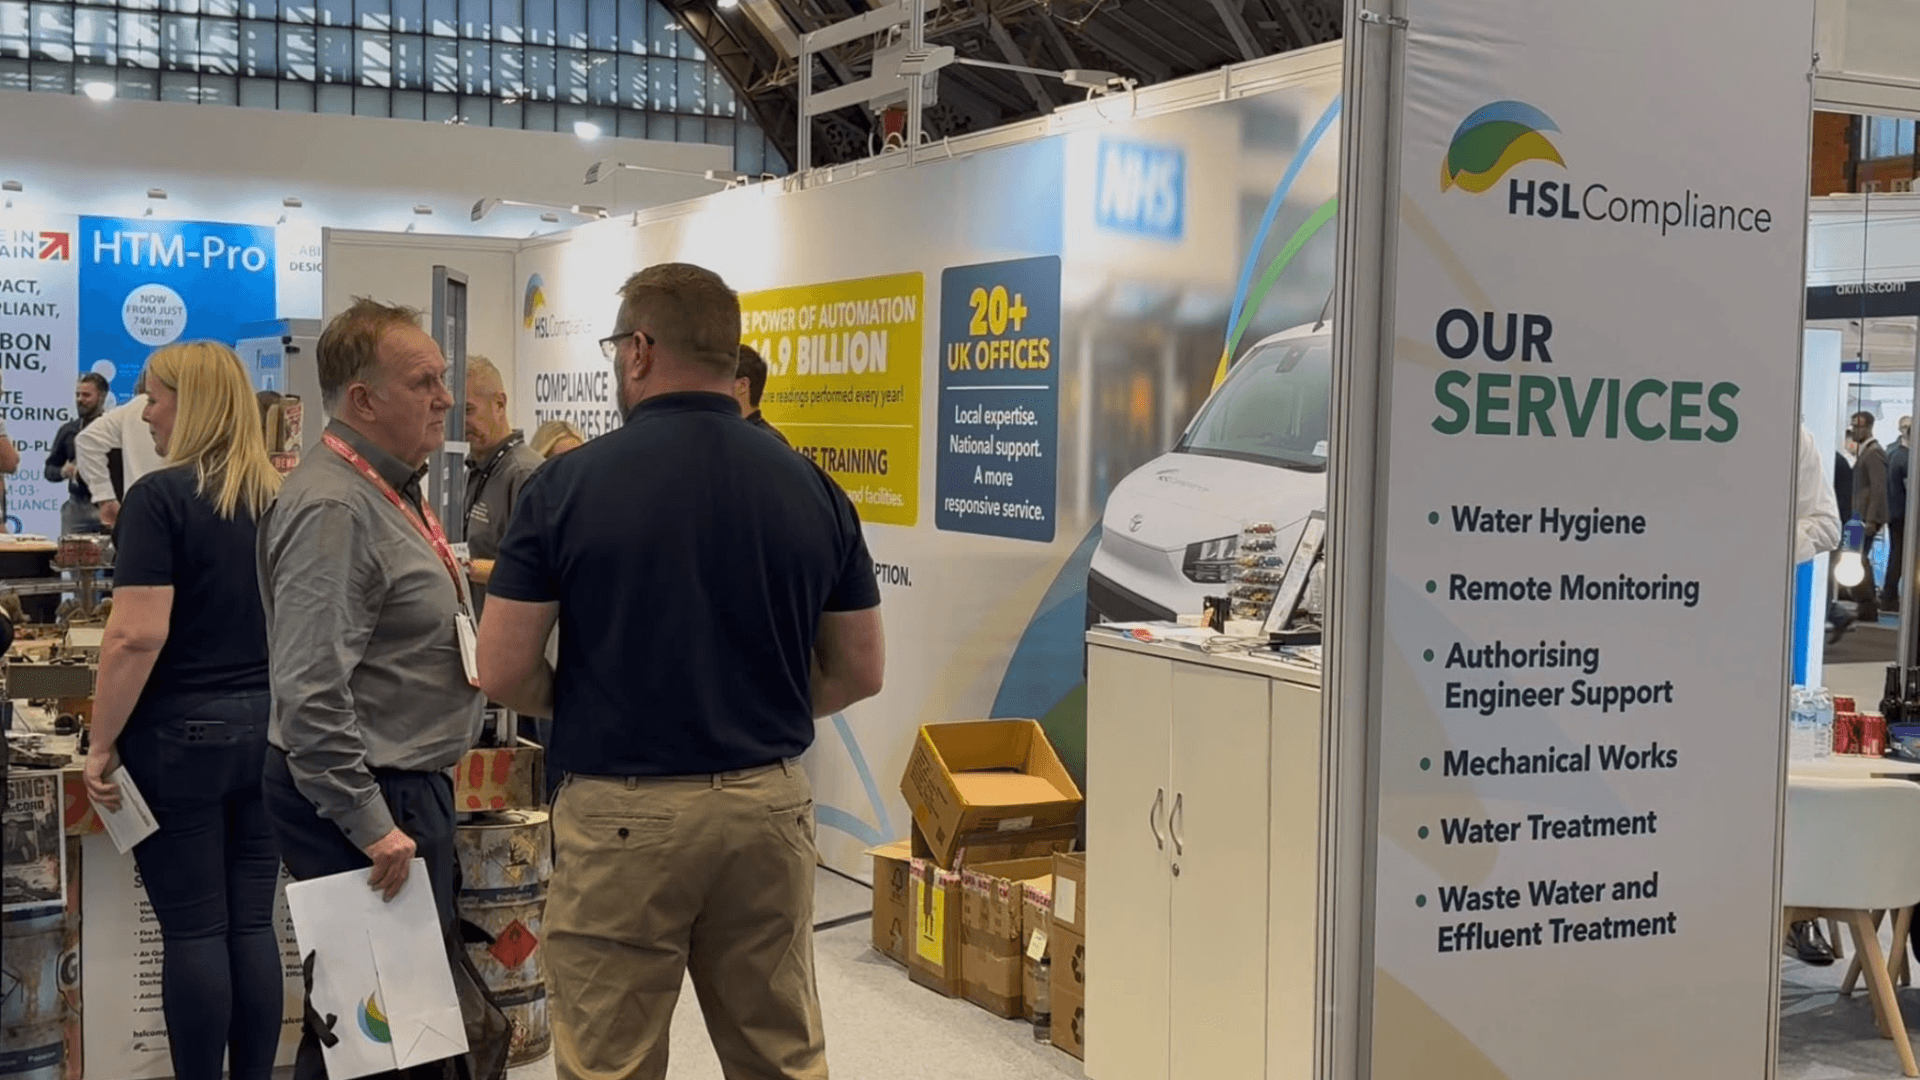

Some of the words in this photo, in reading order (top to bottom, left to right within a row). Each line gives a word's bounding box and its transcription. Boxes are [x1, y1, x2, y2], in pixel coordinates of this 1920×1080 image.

[1100, 149, 1176, 226] NHS
[1508, 178, 1772, 236] HSLCompliance
[93, 229, 267, 273] HTM-Pro
[0, 279, 41, 296] ACT,
[140, 294, 167, 304] NOW
[0, 301, 60, 319] LIANT,
[126, 304, 157, 315] FROM
[157, 305, 183, 316] JUST
[133, 316, 153, 326] 740
[154, 318, 174, 327] mm
[751, 307, 796, 333] POWER
[799, 304, 817, 330] OF
[818, 294, 917, 329] AUTOMATION
[968, 284, 1028, 336] 20+
[140, 327, 167, 337] WIDE
[1435, 307, 1553, 363] OUR
[796, 329, 888, 376] BILLION
[947, 342, 972, 371] UK
[974, 337, 1051, 370] OFFICES
[535, 370, 610, 403] COMPLIANCE
[810, 384, 854, 408] performed
[855, 389, 880, 409] every
[879, 384, 905, 409] year!
[955, 403, 983, 425] Local
[983, 405, 1039, 431] expertise.
[1431, 369, 1741, 443] SERVICES
[820, 446, 888, 476] TRAINING
[949, 433, 995, 455] National
[995, 439, 1043, 462] support.
[973, 464, 983, 484] A
[984, 469, 1014, 487] more
[945, 495, 1001, 518] responsive
[1001, 499, 1046, 521] service.
[1451, 505, 1533, 534] Water
[1539, 506, 1647, 542] Hygiene
[1449, 573, 1553, 602] Remote
[1559, 572, 1701, 608] Monitoring
[1444, 639, 1600, 675] Authorising
[1445, 680, 1565, 716] Engineer
[1570, 679, 1674, 713] Support
[1442, 744, 1592, 777] Mechanical
[1598, 741, 1679, 771] Works
[1440, 816, 1522, 845] Water
[1527, 810, 1658, 842] Treatment
[1437, 883, 1522, 913] Waste
[1527, 878, 1606, 907] Water
[1611, 871, 1660, 900] and
[1437, 920, 1543, 953] Effluent
[1548, 910, 1678, 945] Treatment
